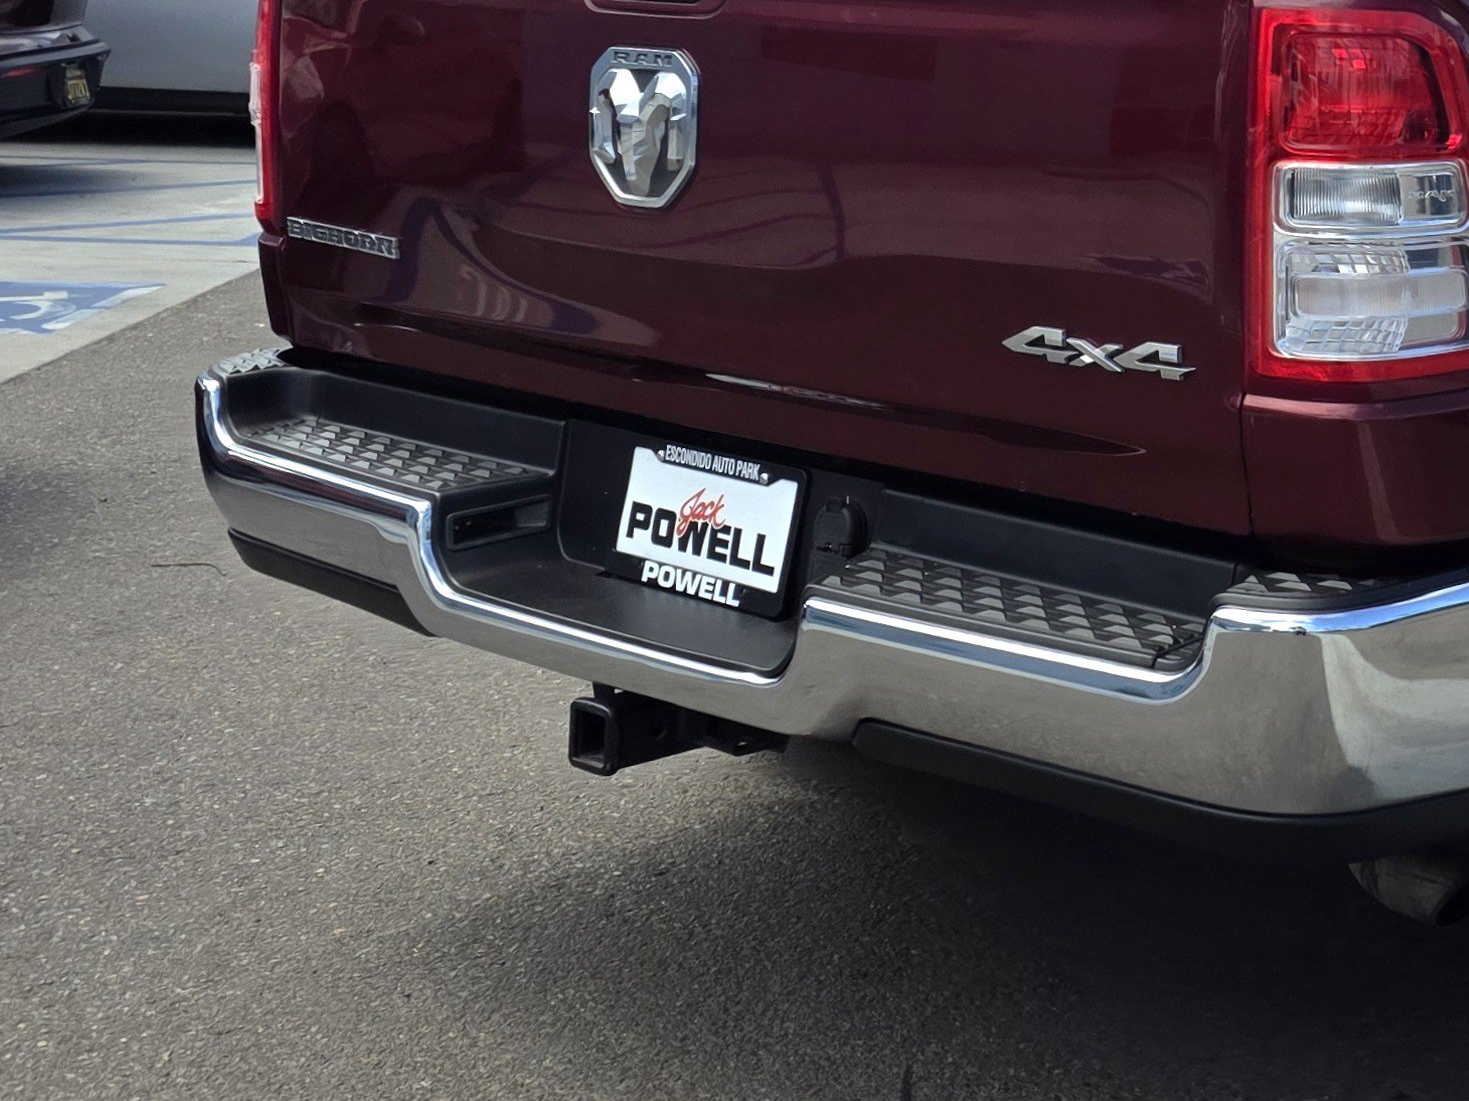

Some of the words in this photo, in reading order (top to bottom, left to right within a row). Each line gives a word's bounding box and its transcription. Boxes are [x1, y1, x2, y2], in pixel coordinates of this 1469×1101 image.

[611, 51, 673, 67] RAM
[287, 216, 400, 260] BIGHORN
[665, 444, 713, 470] ESCONDIDO
[712, 455, 736, 476] AUTO
[735, 459, 761, 481] PARK
[676, 487, 726, 536] Jack
[626, 500, 775, 577] POWELL
[641, 560, 740, 608] POWELL
